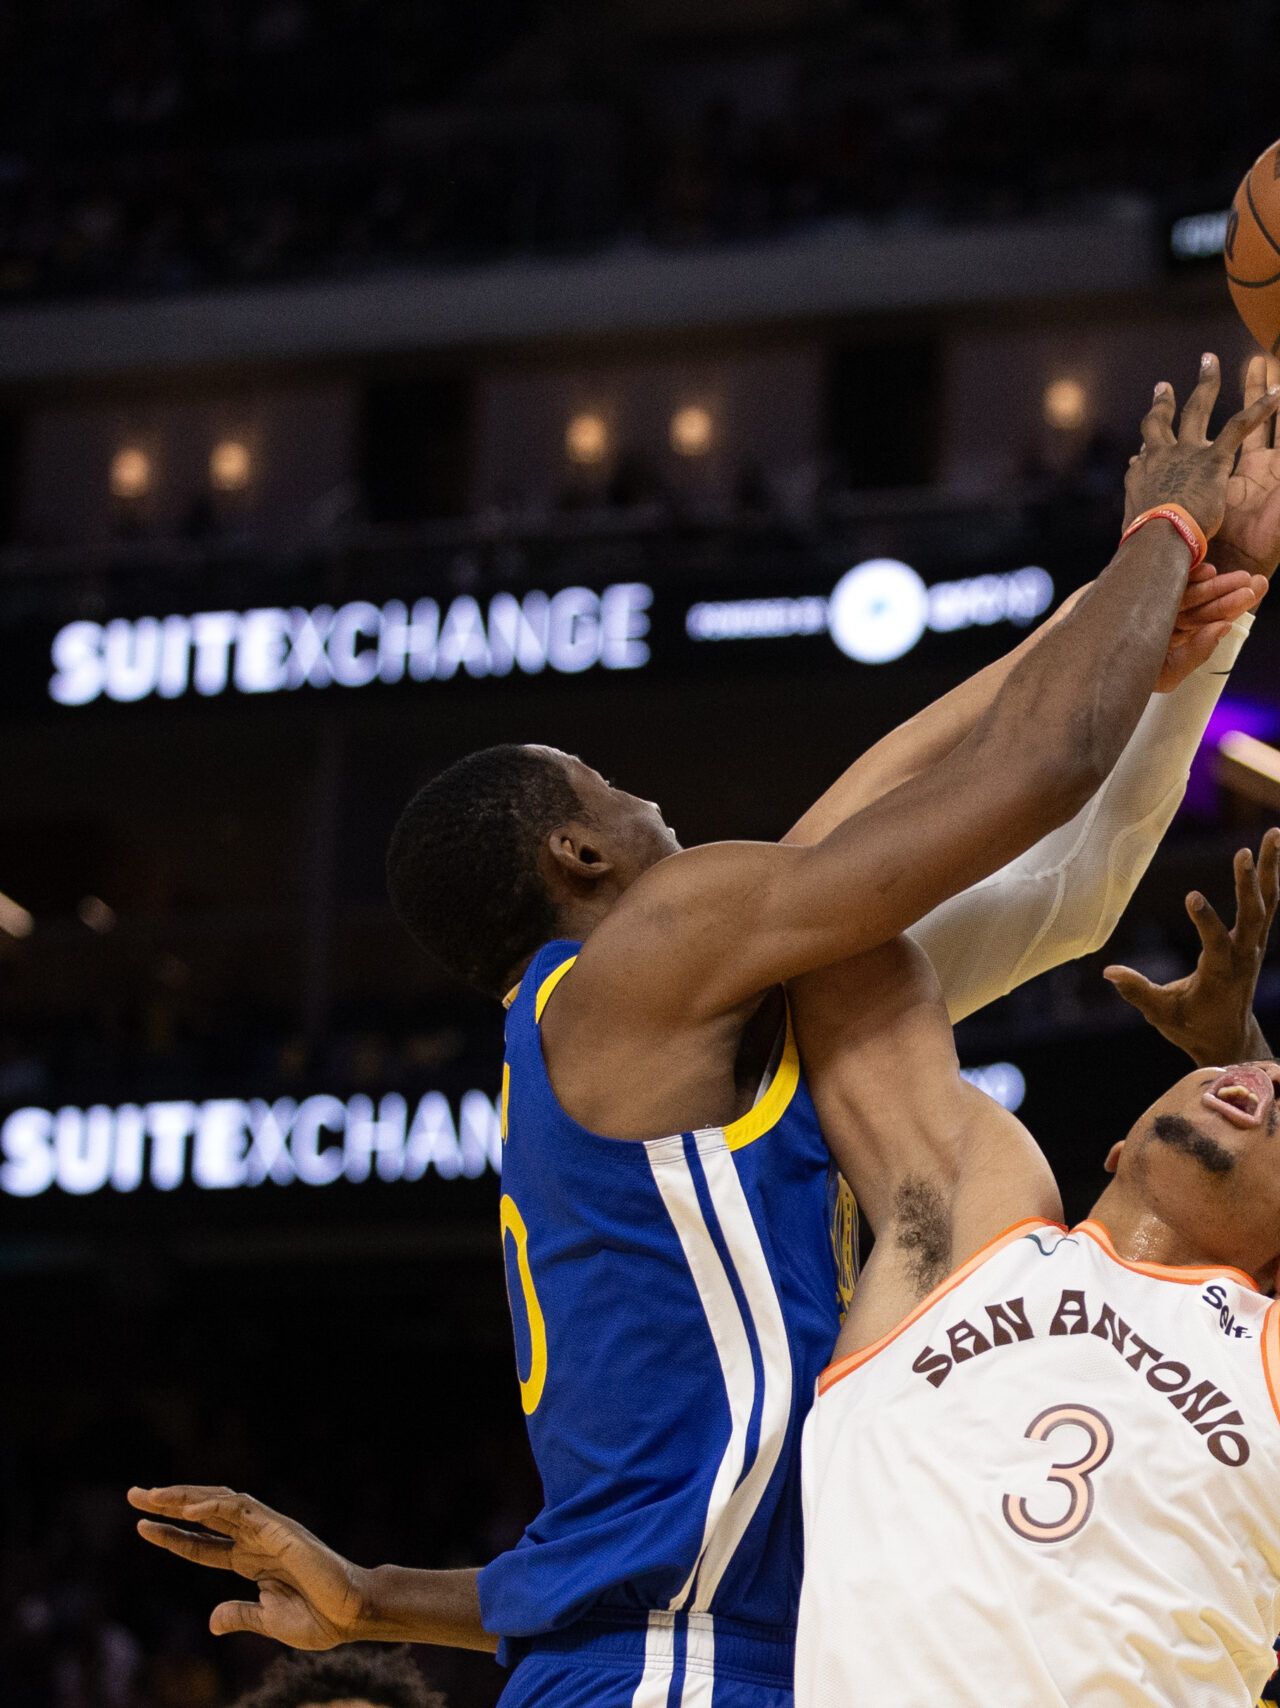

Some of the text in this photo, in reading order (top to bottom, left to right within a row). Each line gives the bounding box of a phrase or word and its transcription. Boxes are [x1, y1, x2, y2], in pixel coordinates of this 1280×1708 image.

[49, 582, 654, 708] SUITEXCHANGE
[912, 1289, 1250, 1468] SAN ANTONIO
[1001, 1403, 1114, 1544] 3
